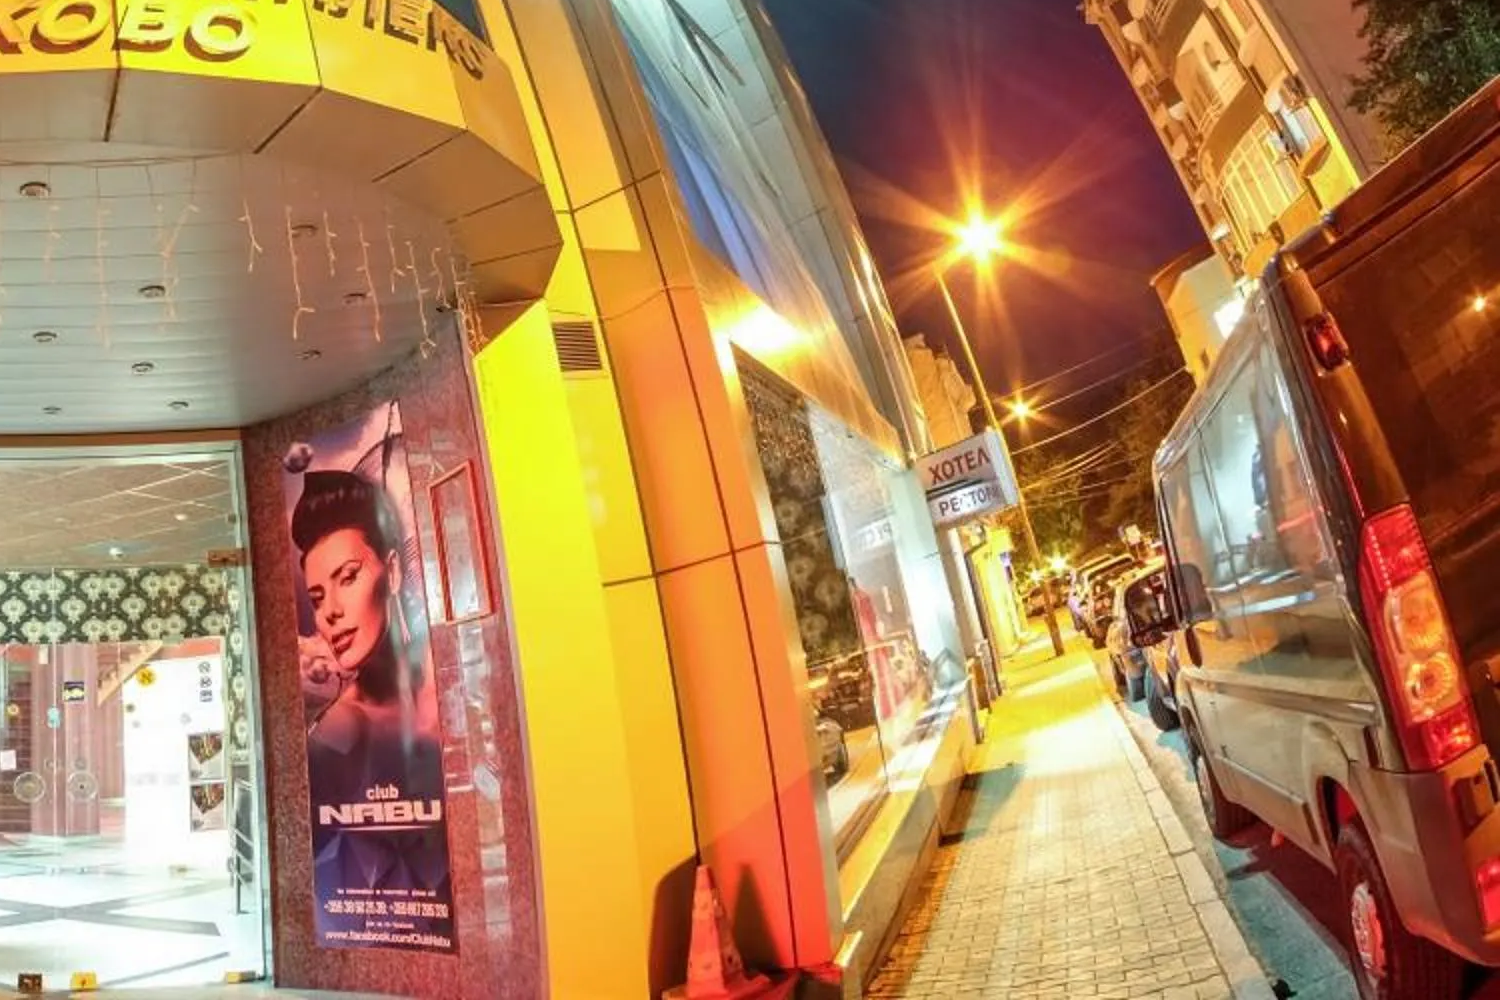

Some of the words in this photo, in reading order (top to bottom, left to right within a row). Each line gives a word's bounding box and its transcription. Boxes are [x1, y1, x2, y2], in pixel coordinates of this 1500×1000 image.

[928, 447, 991, 485] ХОТЕЛ
[365, 784, 399, 800] club
[318, 799, 442, 825] NABU
